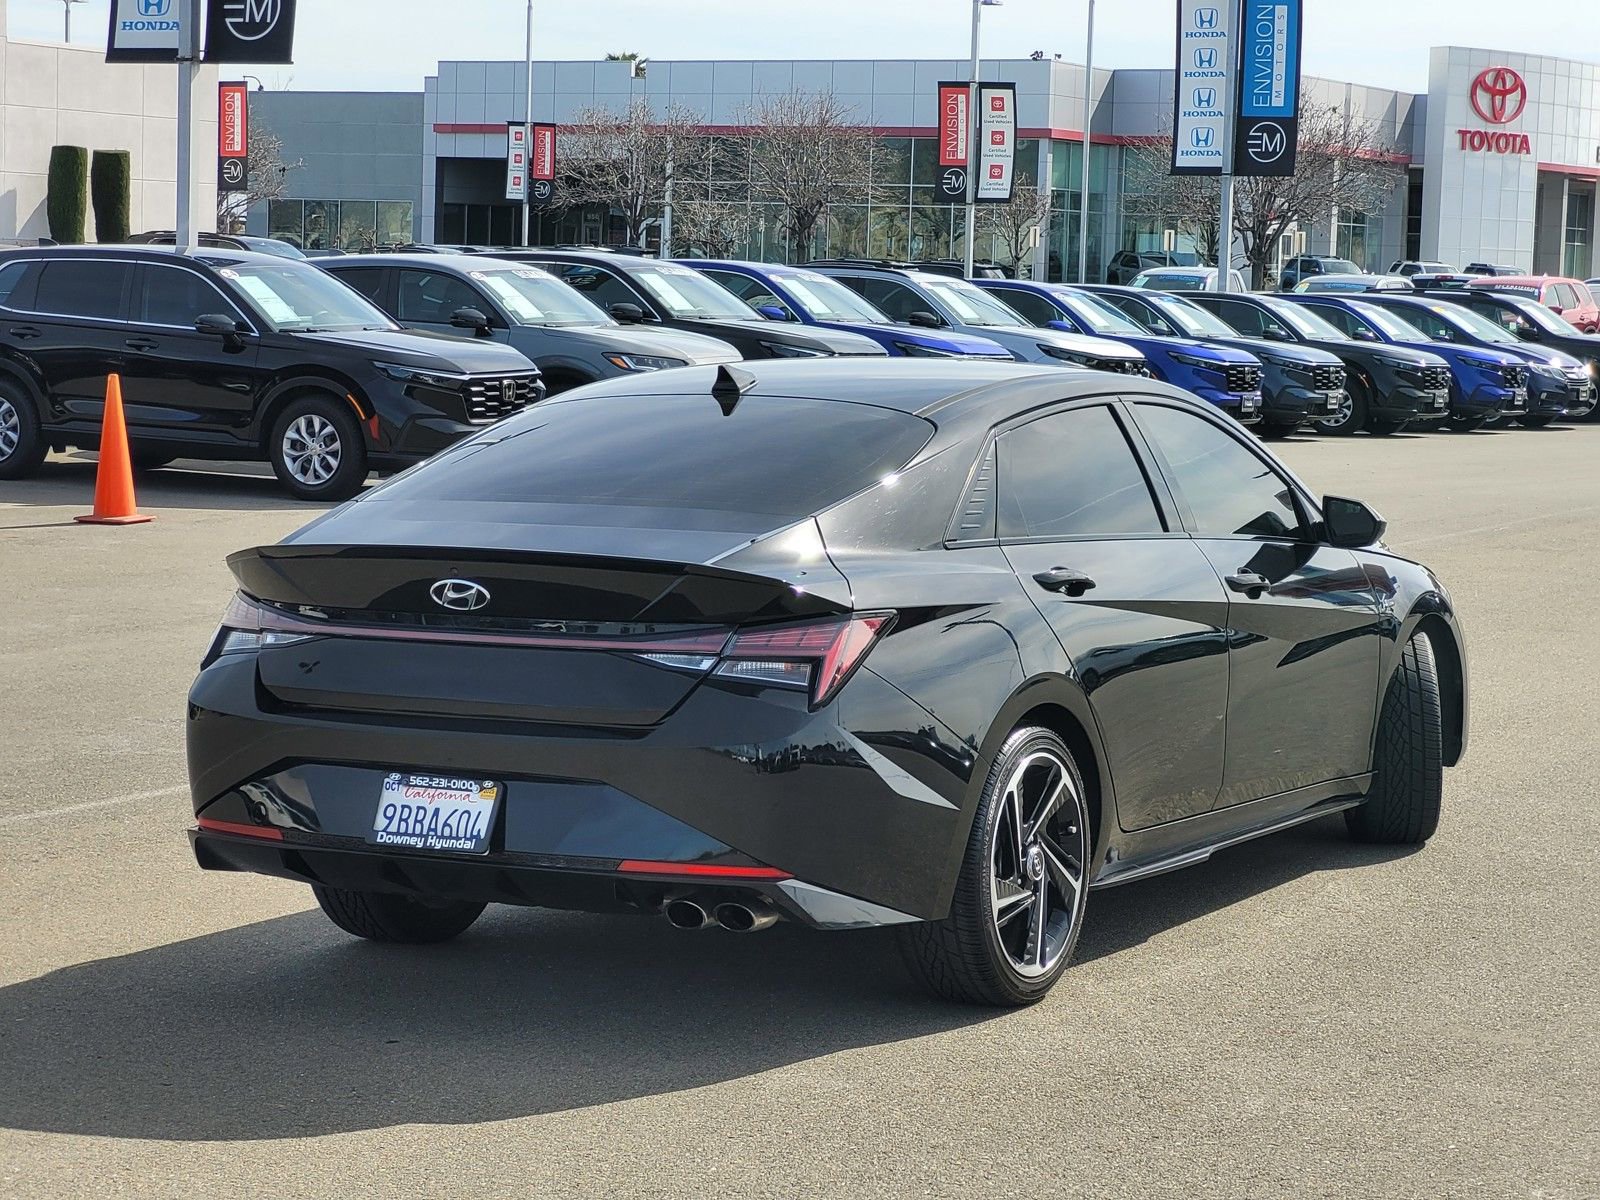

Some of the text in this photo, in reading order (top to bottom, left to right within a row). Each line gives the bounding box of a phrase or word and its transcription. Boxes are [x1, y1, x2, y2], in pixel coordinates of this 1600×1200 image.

[120, 21, 180, 31] HONDA
[1253, 4, 1274, 107] ENVISION
[1274, 14, 1284, 99] MOTORS
[225, 92, 235, 151] ENVISION
[946, 94, 958, 160] ENVISION
[537, 130, 546, 175] ENVISION
[1457, 129, 1531, 154] TOYOTA
[384, 781, 401, 792] OCT
[404, 786, 477, 805] California
[409, 776, 475, 790] 562-231-0100
[376, 832, 424, 848] Downey
